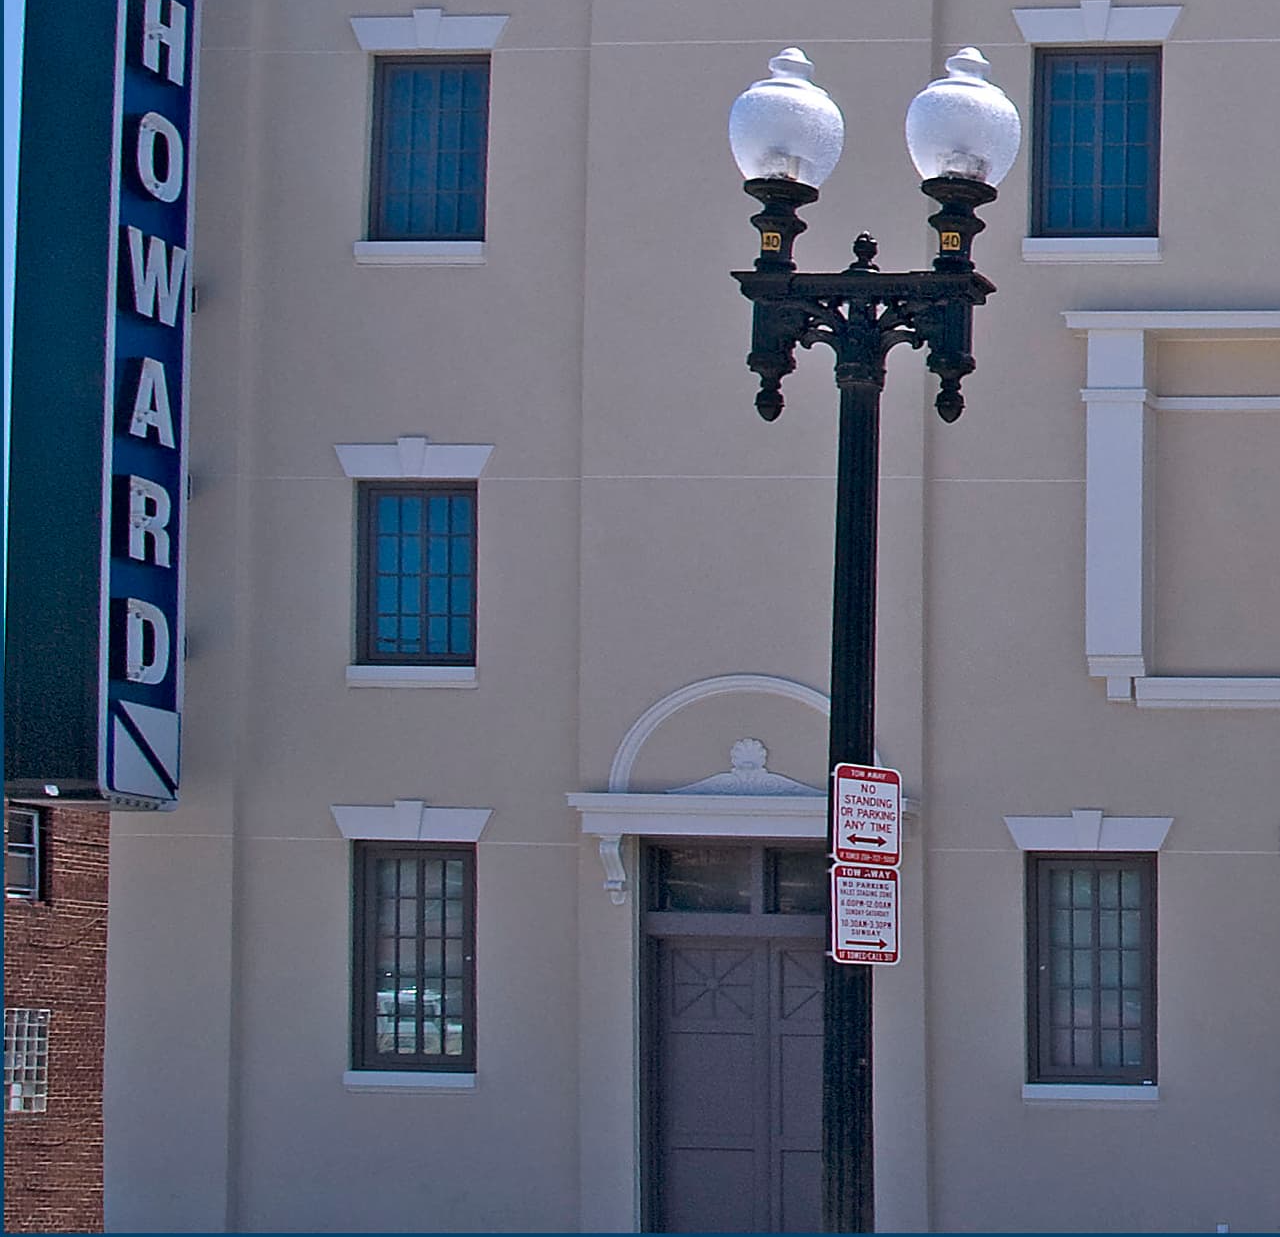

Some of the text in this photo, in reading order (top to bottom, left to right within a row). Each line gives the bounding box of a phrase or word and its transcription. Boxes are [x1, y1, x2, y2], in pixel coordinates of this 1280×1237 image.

[763, 234, 779, 248] 40
[942, 234, 959, 248] 40
[860, 783, 877, 795] NO
[844, 794, 893, 809] STANDING
[841, 806, 896, 822] OR PARKING
[844, 819, 893, 834] ANY TIME
[841, 867, 891, 880] TOW AWAY
[856, 881, 889, 891] PARKING
[851, 928, 881, 936] SUNDAY
